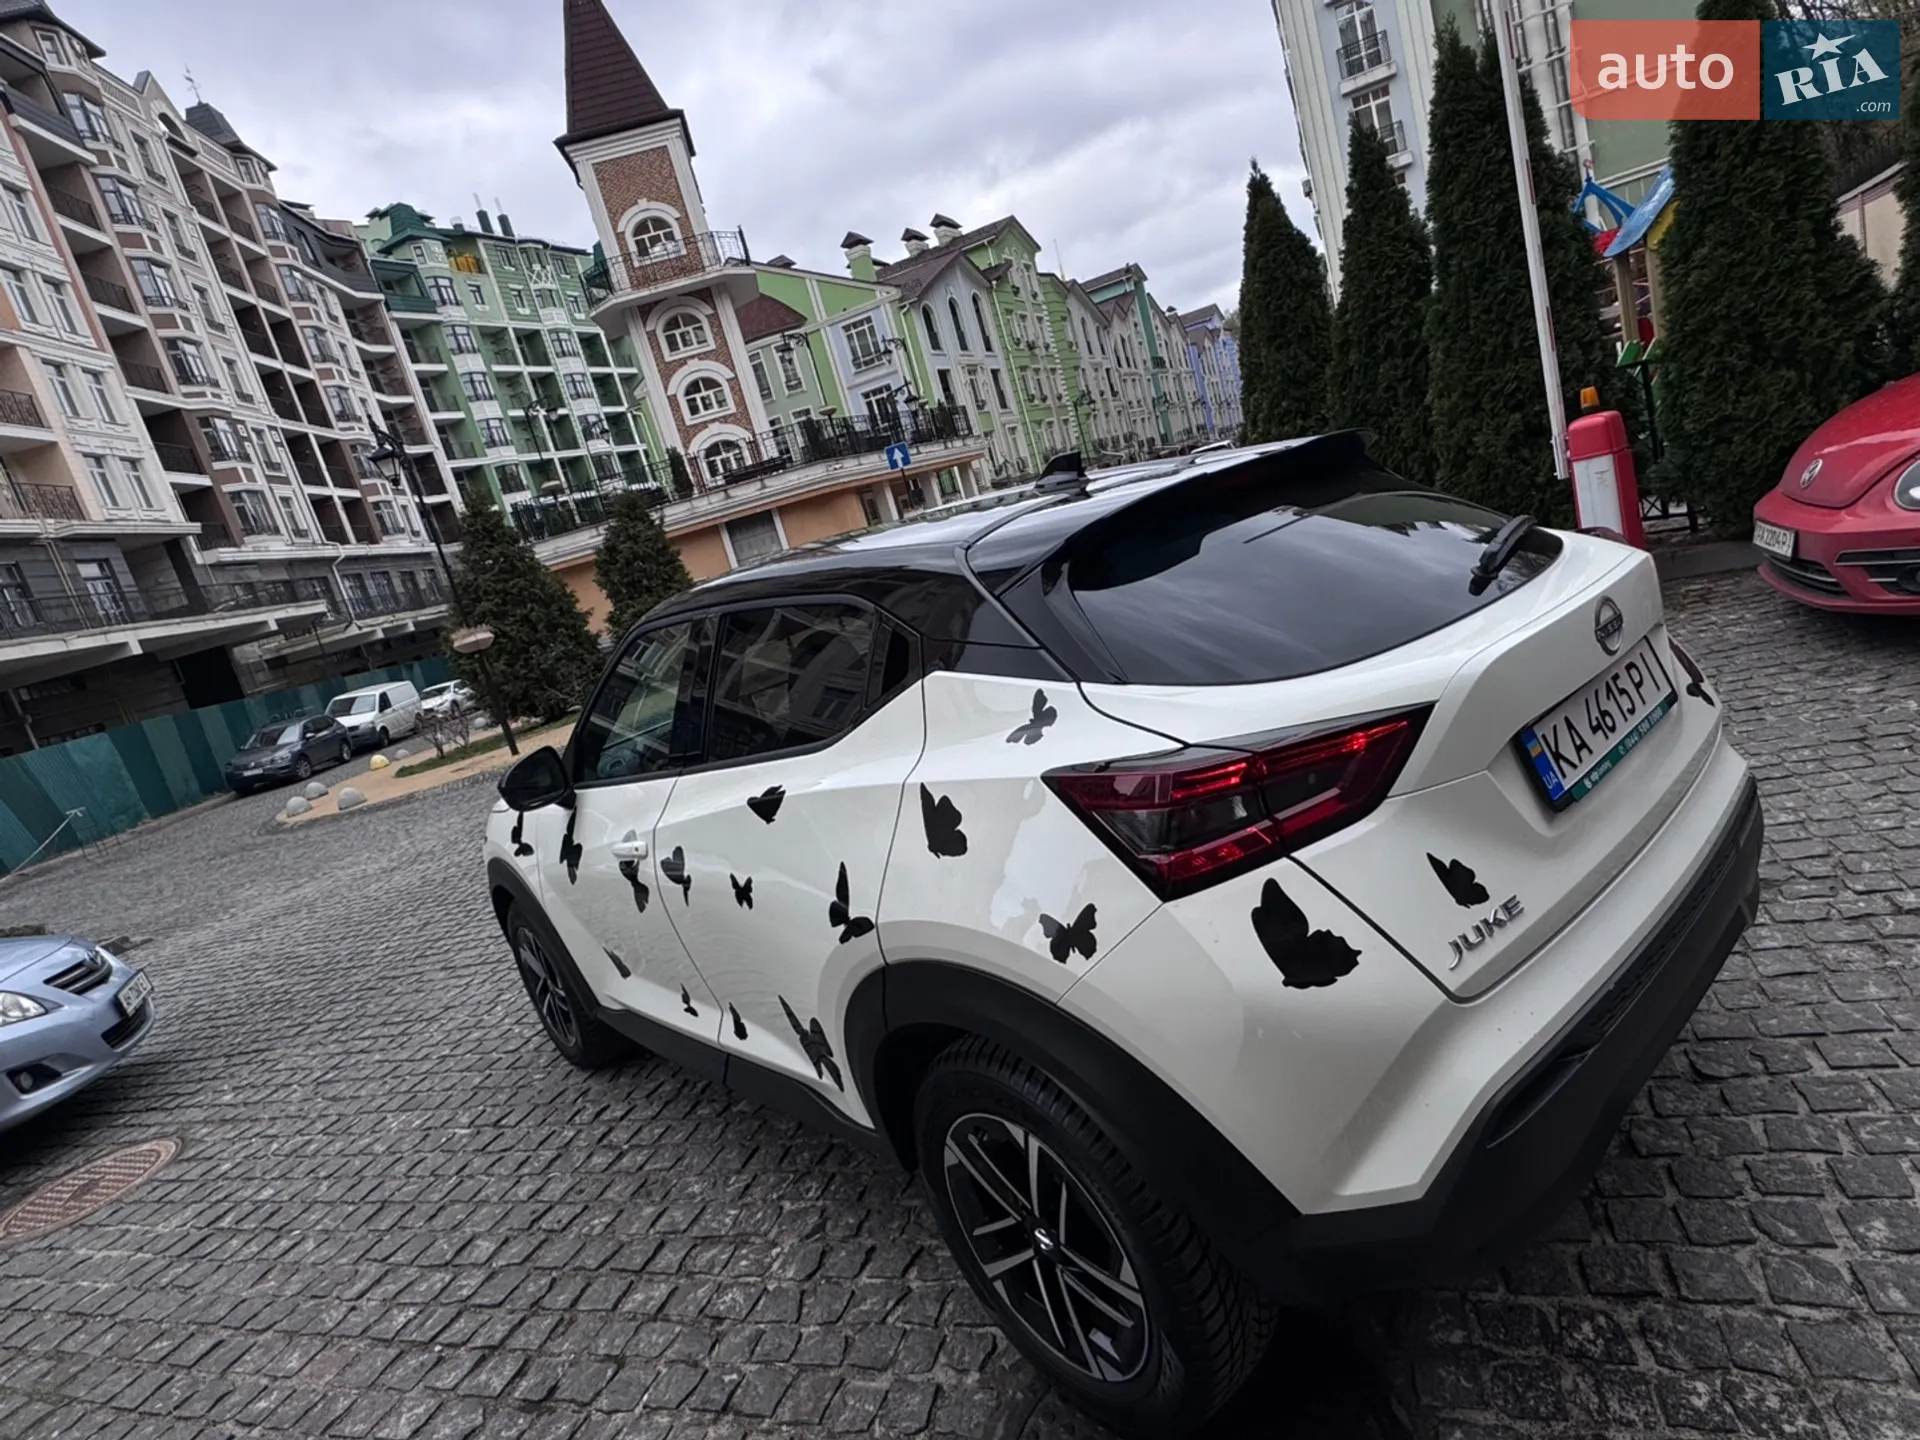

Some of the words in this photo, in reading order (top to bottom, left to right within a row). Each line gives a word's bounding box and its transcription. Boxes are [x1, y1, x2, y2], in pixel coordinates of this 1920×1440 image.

[1541, 715, 1593, 779] KA
[1585, 672, 1636, 740] 4615
[1624, 652, 1661, 706] PI
[1543, 771, 1559, 789] UA
[1448, 894, 1524, 971] JUKE
